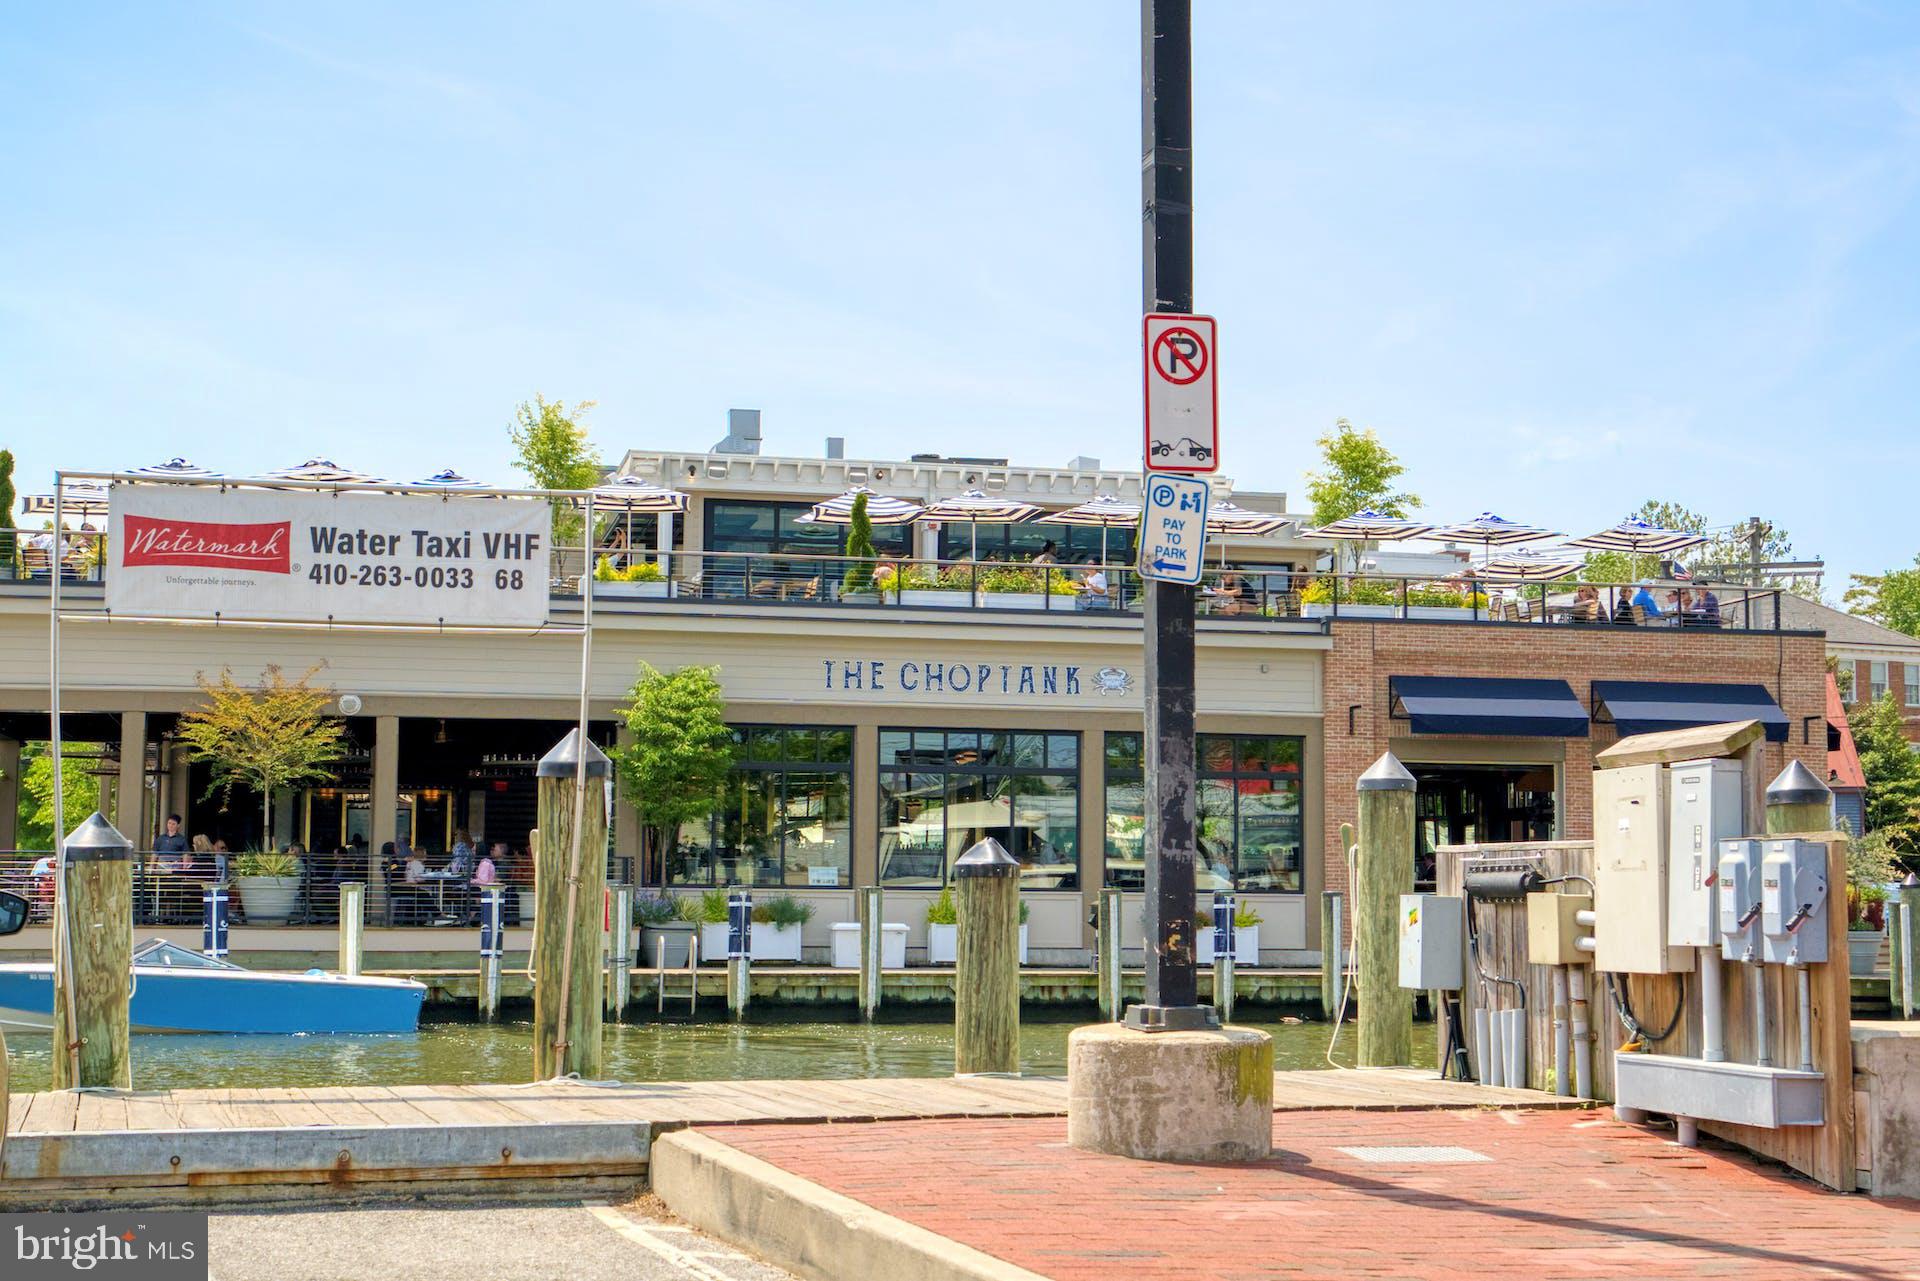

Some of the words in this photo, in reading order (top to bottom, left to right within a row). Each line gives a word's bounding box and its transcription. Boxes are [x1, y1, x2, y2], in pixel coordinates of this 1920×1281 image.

[1162, 518, 1186, 531] PAY
[129, 527, 285, 555] Watermark
[310, 526, 401, 556] Water
[411, 530, 471, 559] Taxi
[482, 532, 541, 561] VHF
[1165, 532, 1182, 545] TO
[1154, 545, 1188, 561] PARK
[166, 576, 219, 586] Unforgettable
[221, 577, 257, 587] journeys.
[309, 563, 474, 589] 410-263-0033
[495, 569, 524, 590] 68
[822, 660, 884, 690] THE
[900, 662, 1081, 694] CHOPTANK
